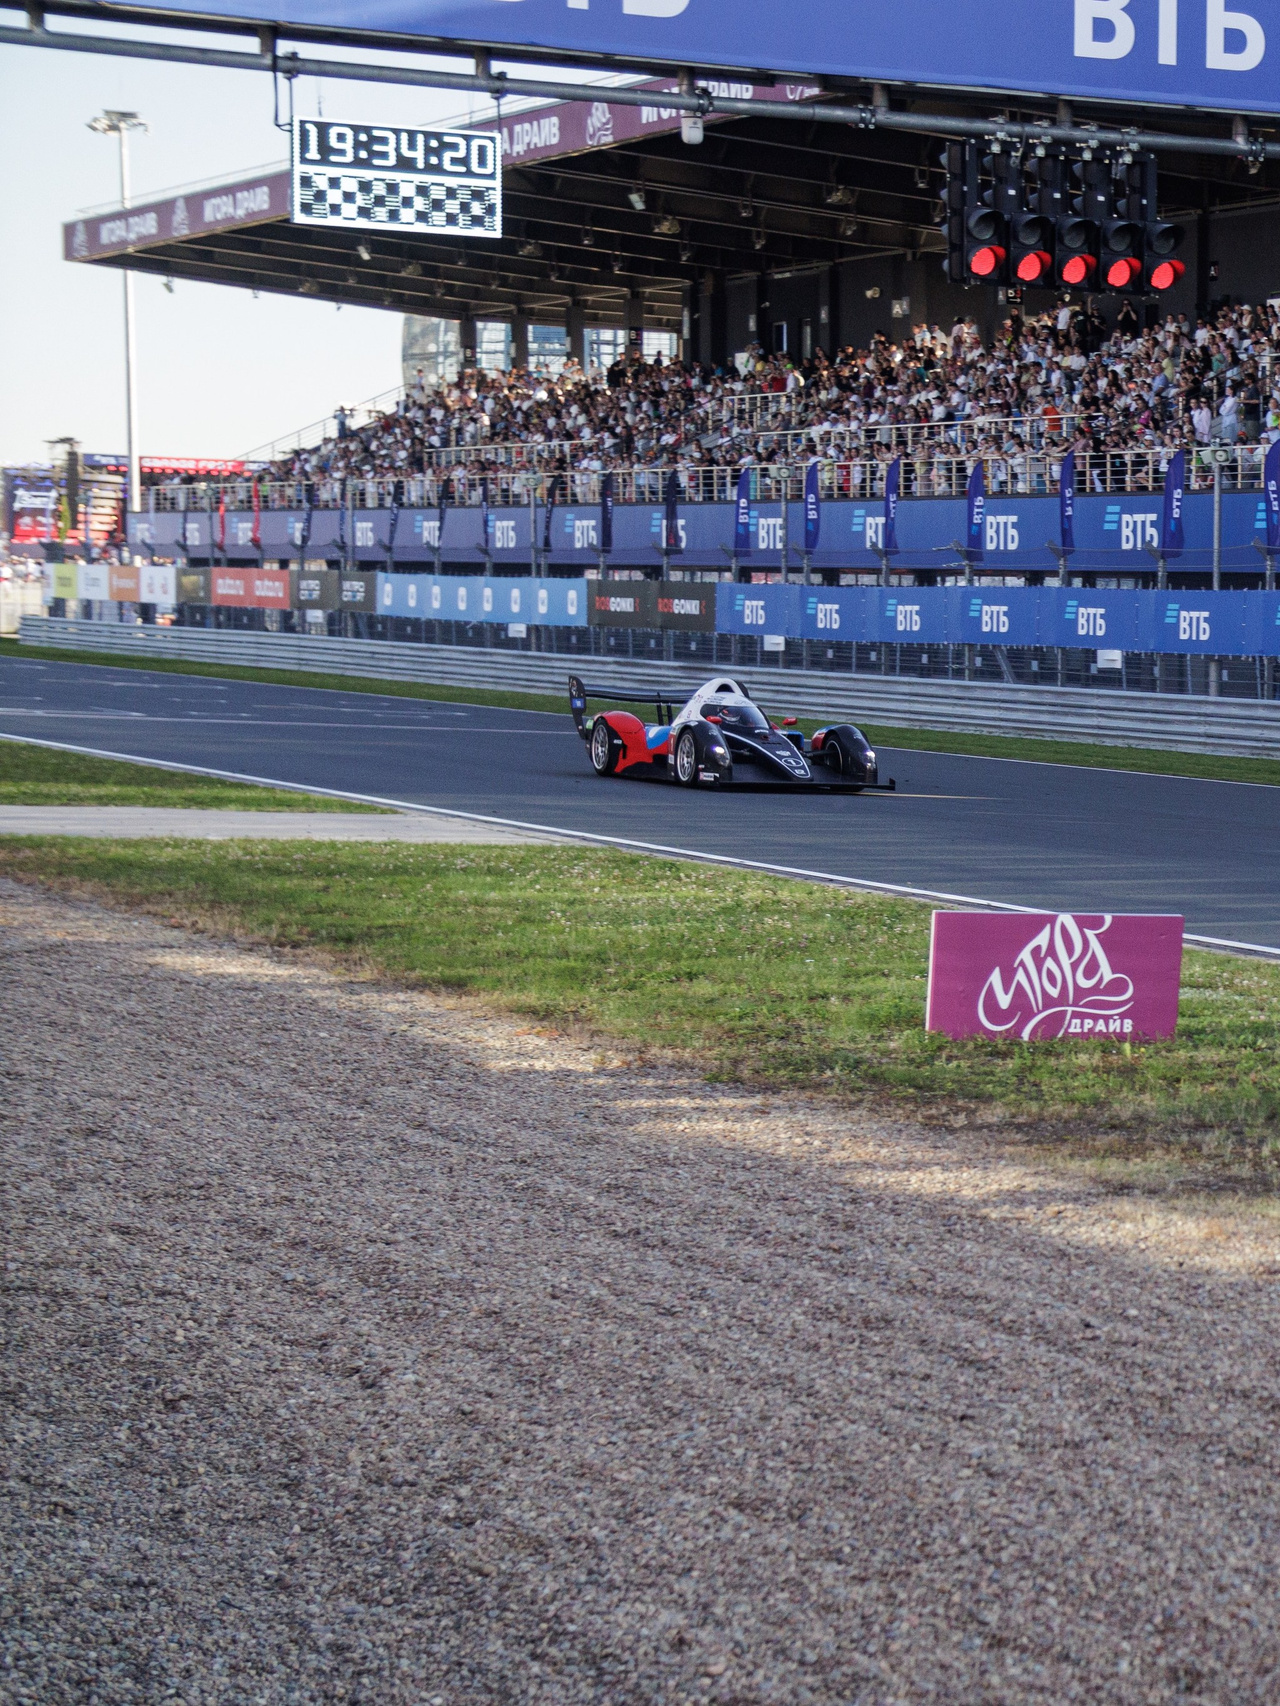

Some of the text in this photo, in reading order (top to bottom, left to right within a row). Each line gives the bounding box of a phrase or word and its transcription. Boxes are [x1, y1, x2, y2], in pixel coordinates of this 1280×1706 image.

[305, 123, 494, 175] 19:34:20
[972, 496, 984, 524] ВТБ
[495, 521, 516, 548] ВТБ
[866, 516, 886, 550] ВТ
[986, 515, 1019, 550] ВТБ
[1121, 513, 1159, 551] ВТБ
[743, 600, 766, 625] ВТБ
[817, 603, 840, 630] ВТБ
[896, 604, 920, 631] ВТБ
[981, 605, 1009, 633] ВТБ
[1077, 607, 1106, 637] ВТБ
[1179, 611, 1210, 641] ВТБ
[1067, 1016, 1134, 1034] ДРАЙВ
